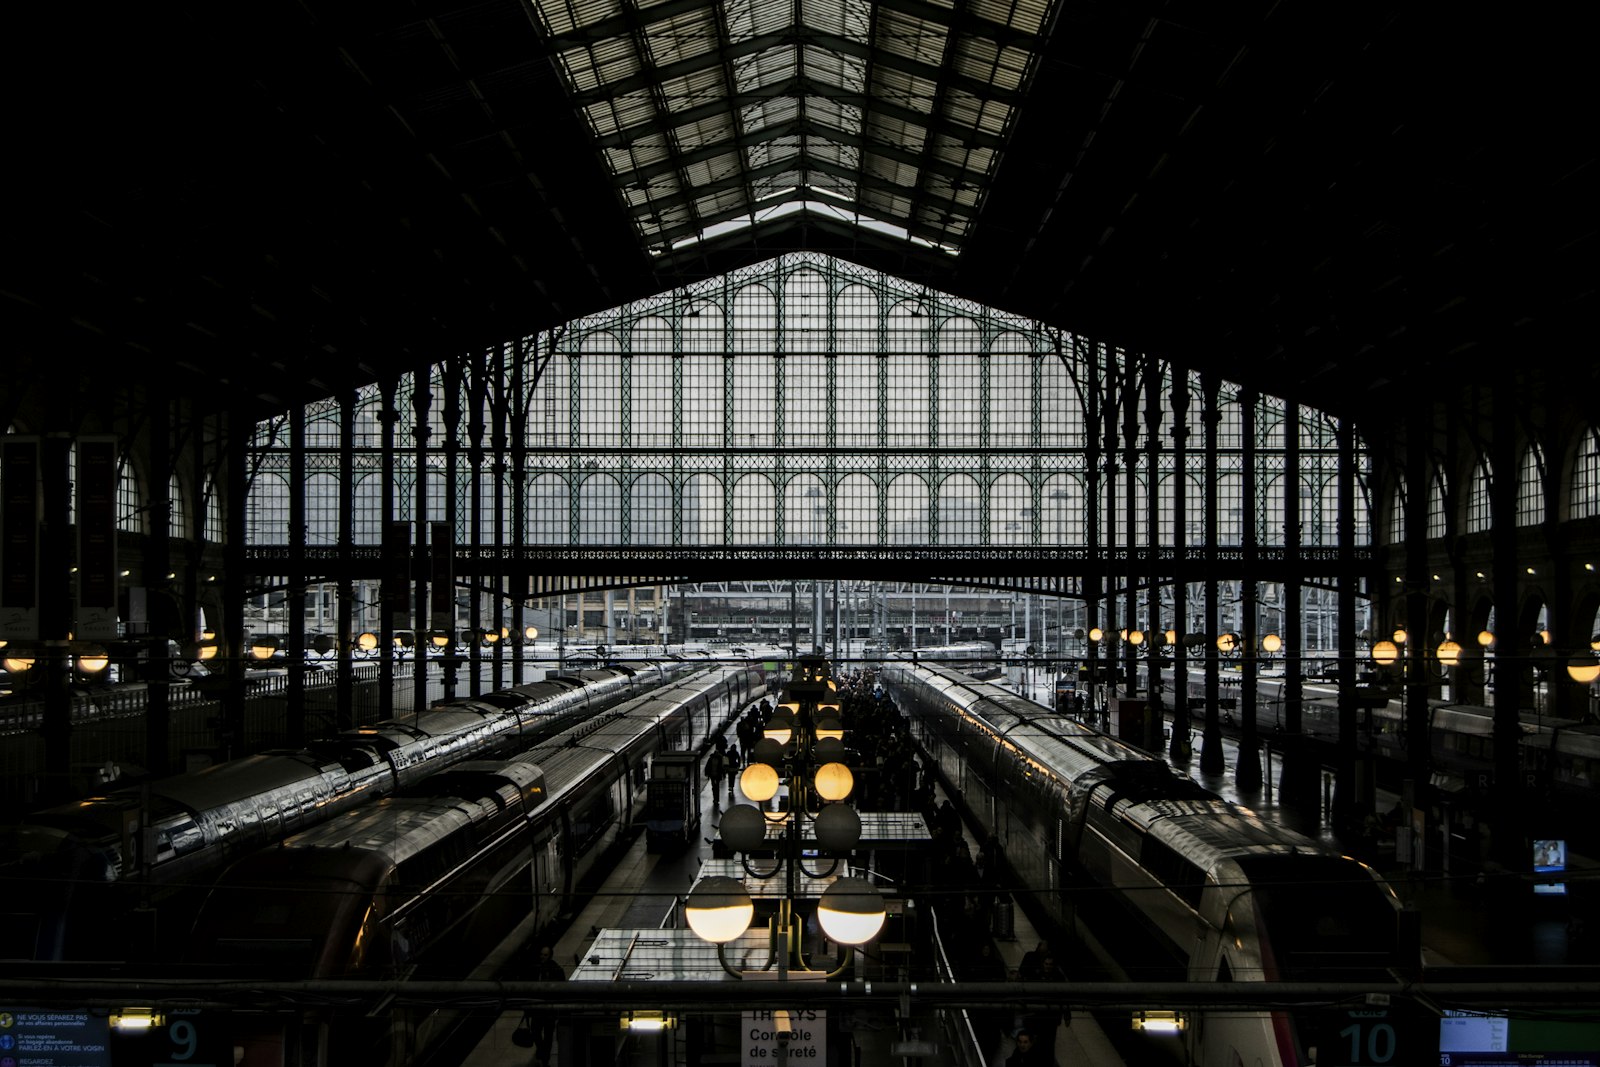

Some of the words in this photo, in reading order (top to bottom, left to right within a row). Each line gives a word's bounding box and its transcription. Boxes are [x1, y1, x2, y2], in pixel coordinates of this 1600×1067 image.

[753, 1009, 816, 1021] THYS
[169, 1020, 198, 1060] 9
[750, 1028, 811, 1041] Conôle
[1339, 1023, 1396, 1063] 10
[750, 1045, 767, 1057] de
[772, 1045, 816, 1057] sreté
[1440, 1057, 1450, 1065] 10
